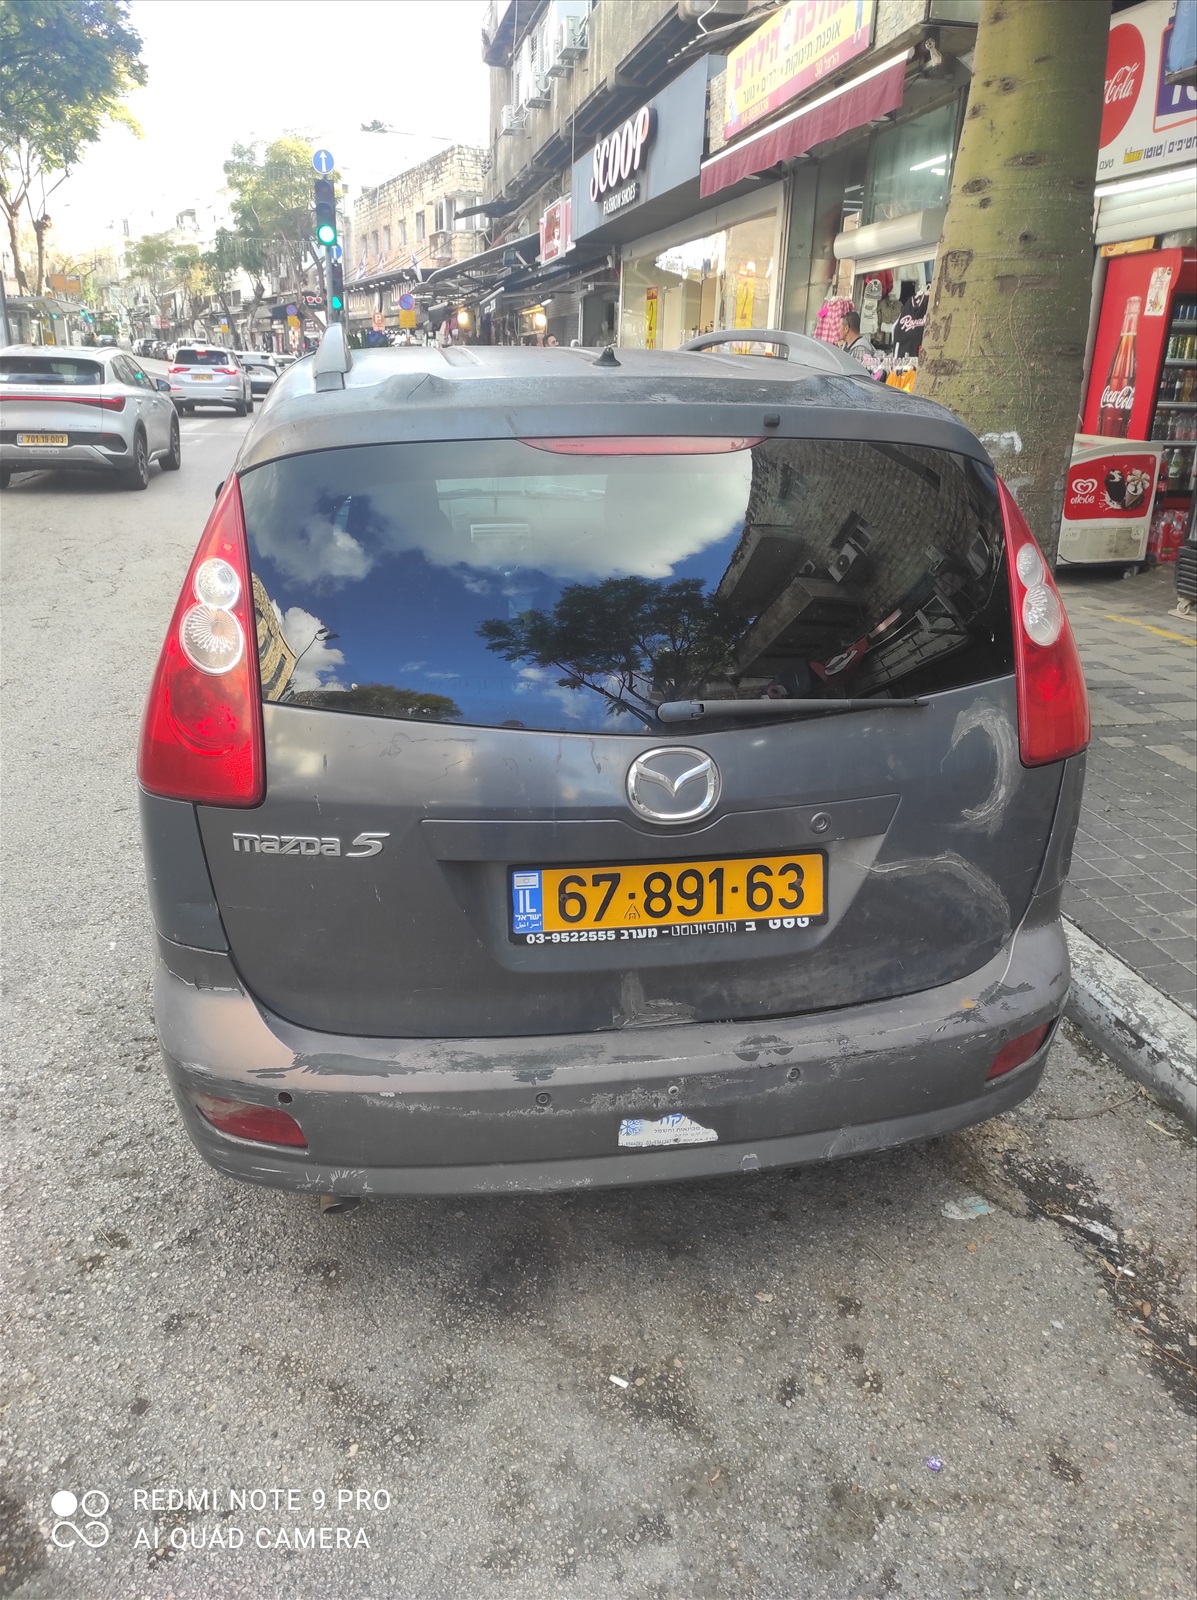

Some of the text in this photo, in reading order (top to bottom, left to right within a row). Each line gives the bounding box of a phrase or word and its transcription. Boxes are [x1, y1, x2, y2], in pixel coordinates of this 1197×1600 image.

[815, 19, 841, 54] אופנת
[734, 24, 781, 90] הילדים
[785, 41, 813, 76] תינוקות
[814, 59, 823, 78] 30
[590, 106, 650, 202] SCOOP
[1143, 144, 1164, 159] טוטו
[603, 182, 637, 216] FASHION SHOES
[1100, 385, 1135, 409] Coca-Cola
[345, 832, 391, 858] 5
[519, 889, 537, 913] IL
[515, 914, 542, 922] ישראל
[526, 930, 616, 944] 03-9522555
[620, 927, 659, 941] מערב
